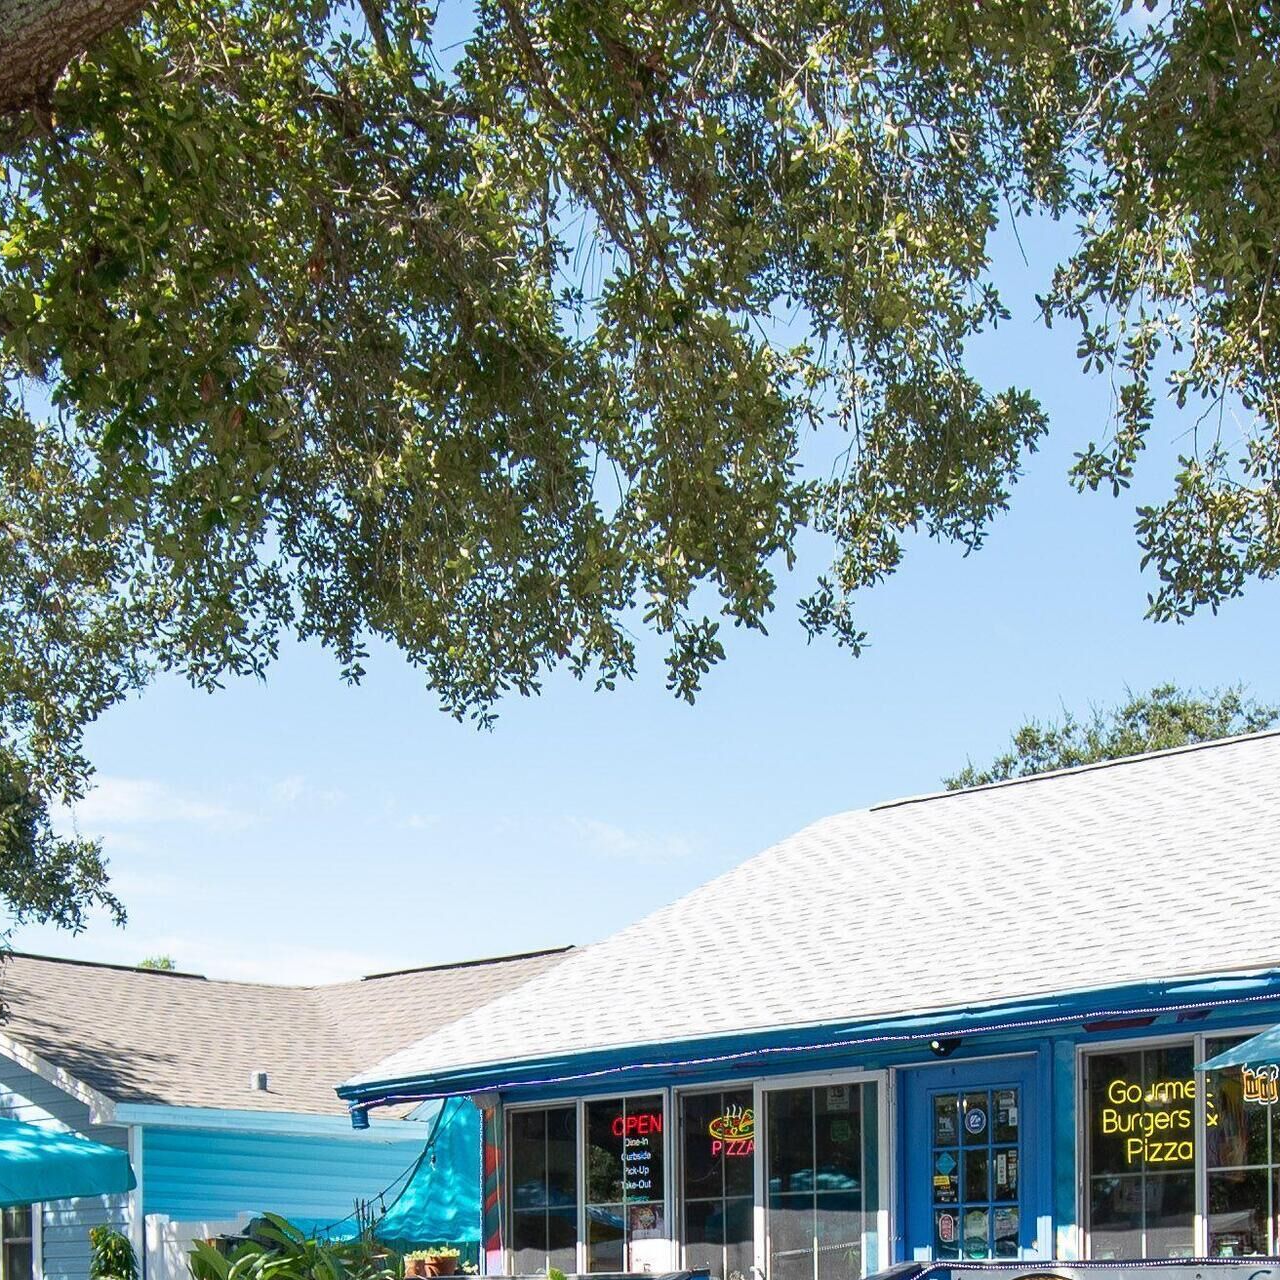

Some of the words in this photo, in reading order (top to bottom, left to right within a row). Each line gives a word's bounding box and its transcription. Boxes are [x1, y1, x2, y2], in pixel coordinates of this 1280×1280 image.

[611, 1113, 663, 1137] OPEN
[1102, 1108, 1192, 1137] Burgers
[711, 1140, 755, 1156] PZZA
[1126, 1138, 1194, 1165] Pizza
